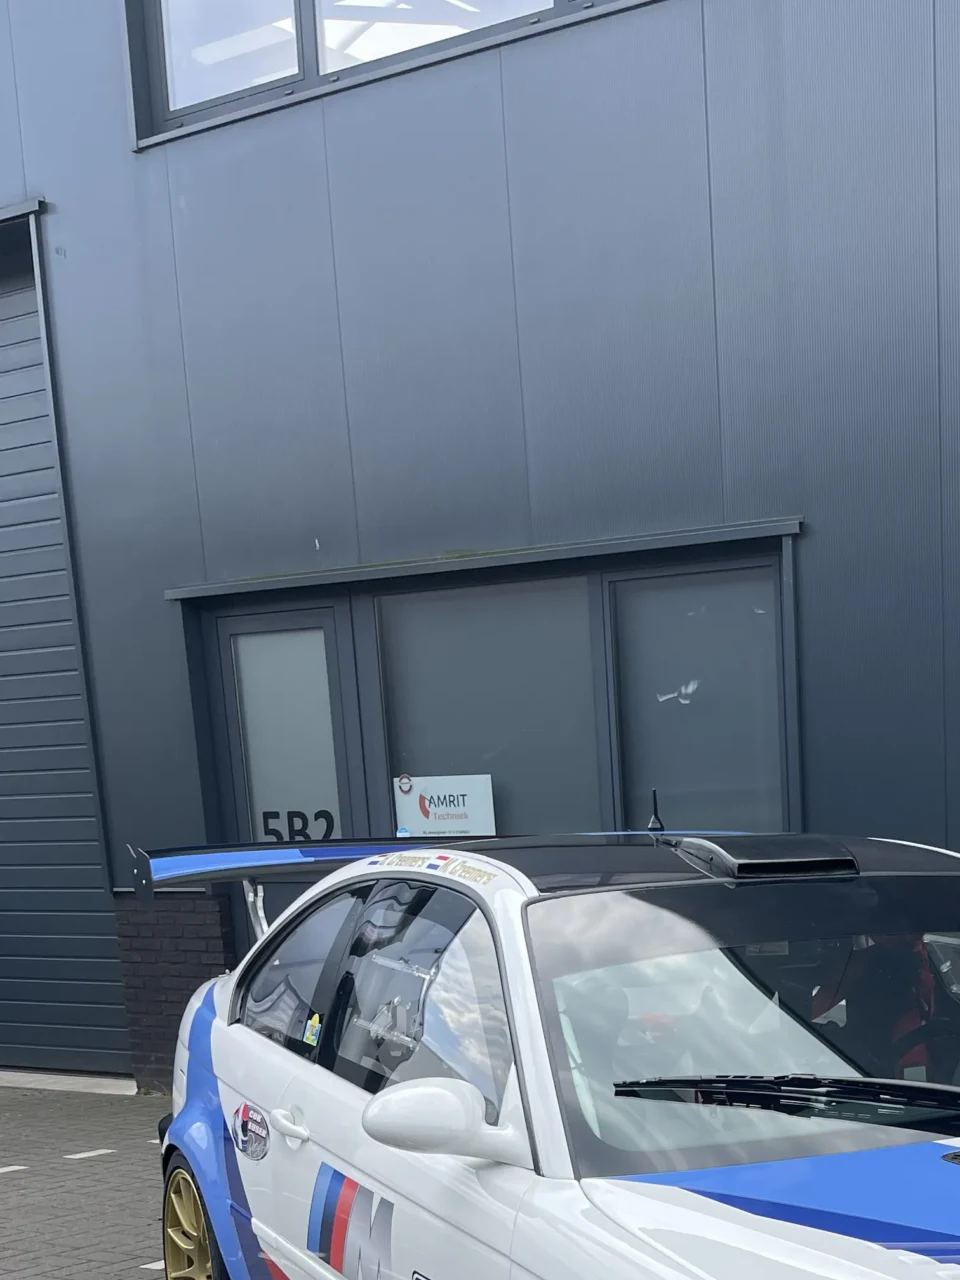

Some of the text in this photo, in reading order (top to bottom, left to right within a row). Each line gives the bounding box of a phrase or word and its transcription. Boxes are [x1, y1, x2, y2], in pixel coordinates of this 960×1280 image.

[428, 794, 467, 808] AMRIT
[433, 812, 469, 821] Techniek
[262, 809, 335, 842] 5B2
